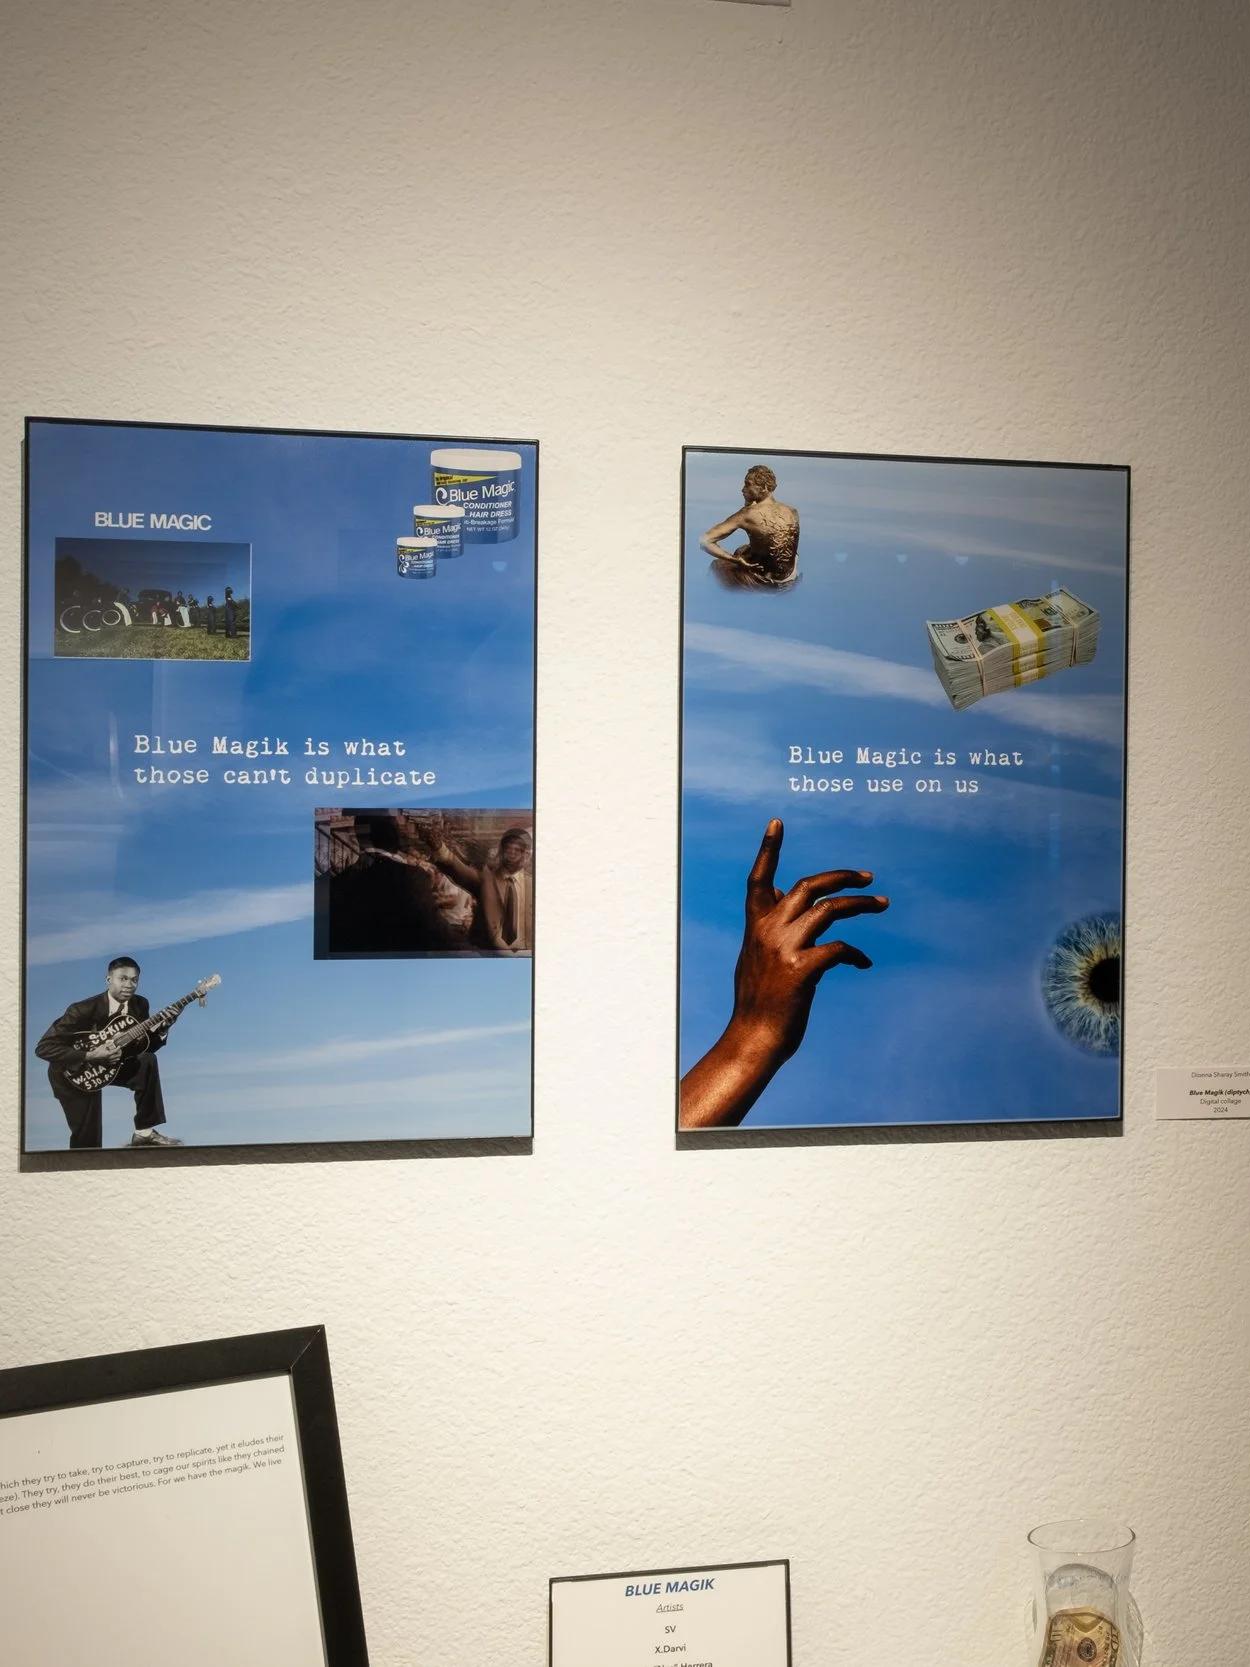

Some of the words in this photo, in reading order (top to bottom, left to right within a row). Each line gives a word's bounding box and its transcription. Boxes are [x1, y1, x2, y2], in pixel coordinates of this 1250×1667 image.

[449, 489, 478, 502] Blue
[482, 480, 515, 498] Magic
[463, 501, 512, 510] CONDITIONER
[491, 510, 512, 518] DRESS
[95, 512, 144, 528] BLUE
[150, 513, 212, 530] MAGIC
[424, 527, 441, 535] Blue
[134, 734, 198, 754] Blue
[212, 736, 289, 758] Magik
[304, 737, 330, 756] is
[344, 738, 405, 756] what
[789, 746, 843, 764] Blue
[856, 747, 921, 767] Magic
[934, 749, 956, 765] is
[969, 750, 1023, 766] what
[134, 766, 209, 784] those
[224, 768, 291, 785] can't
[305, 767, 436, 788] duplicate
[789, 775, 853, 792] those
[867, 777, 903, 792] use
[916, 779, 942, 792] on
[955, 778, 979, 793] us
[0, 1479, 20, 1491] hich
[22, 1476, 41, 1487] they
[44, 1474, 55, 1483] try
[69, 1469, 90, 1478] take,
[92, 1467, 103, 1476] try
[117, 1458, 152, 1470] capture,
[153, 1455, 164, 1464] try
[177, 1447, 214, 1460] replicate,
[216, 1444, 229, 1454] yet
[237, 1438, 264, 1448] eludes
[266, 1434, 284, 1443] their
[0, 1492, 20, 1503] eze).
[22, 1488, 44, 1498] They
[46, 1486, 60, 1496] try,
[62, 1482, 81, 1492] they
[83, 1479, 95, 1488] do
[97, 1476, 117, 1485] their
[119, 1472, 141, 1481] best,
[153, 1466, 174, 1476] cage
[175, 1463, 190, 1471] our
[192, 1458, 217, 1470] spirits
[218, 1455, 232, 1463] like
[234, 1452, 252, 1461] they
[253, 1445, 285, 1458] chained
[6, 1503, 30, 1514] close
[32, 1500, 52, 1509] they
[54, 1495, 69, 1505] will
[71, 1493, 96, 1502] never
[98, 1489, 110, 1497] be
[112, 1480, 156, 1495] victorious.
[157, 1477, 172, 1486] For
[173, 1475, 186, 1483] we
[188, 1471, 208, 1480] have
[209, 1468, 223, 1477] the
[224, 1462, 252, 1474] magik.
[253, 1460, 267, 1469] We
[268, 1458, 282, 1466] live
[625, 1583, 662, 1597] BLUE
[665, 1578, 715, 1594] MAGIK
[656, 1603, 684, 1613] Artists
[665, 1625, 677, 1634] SV
